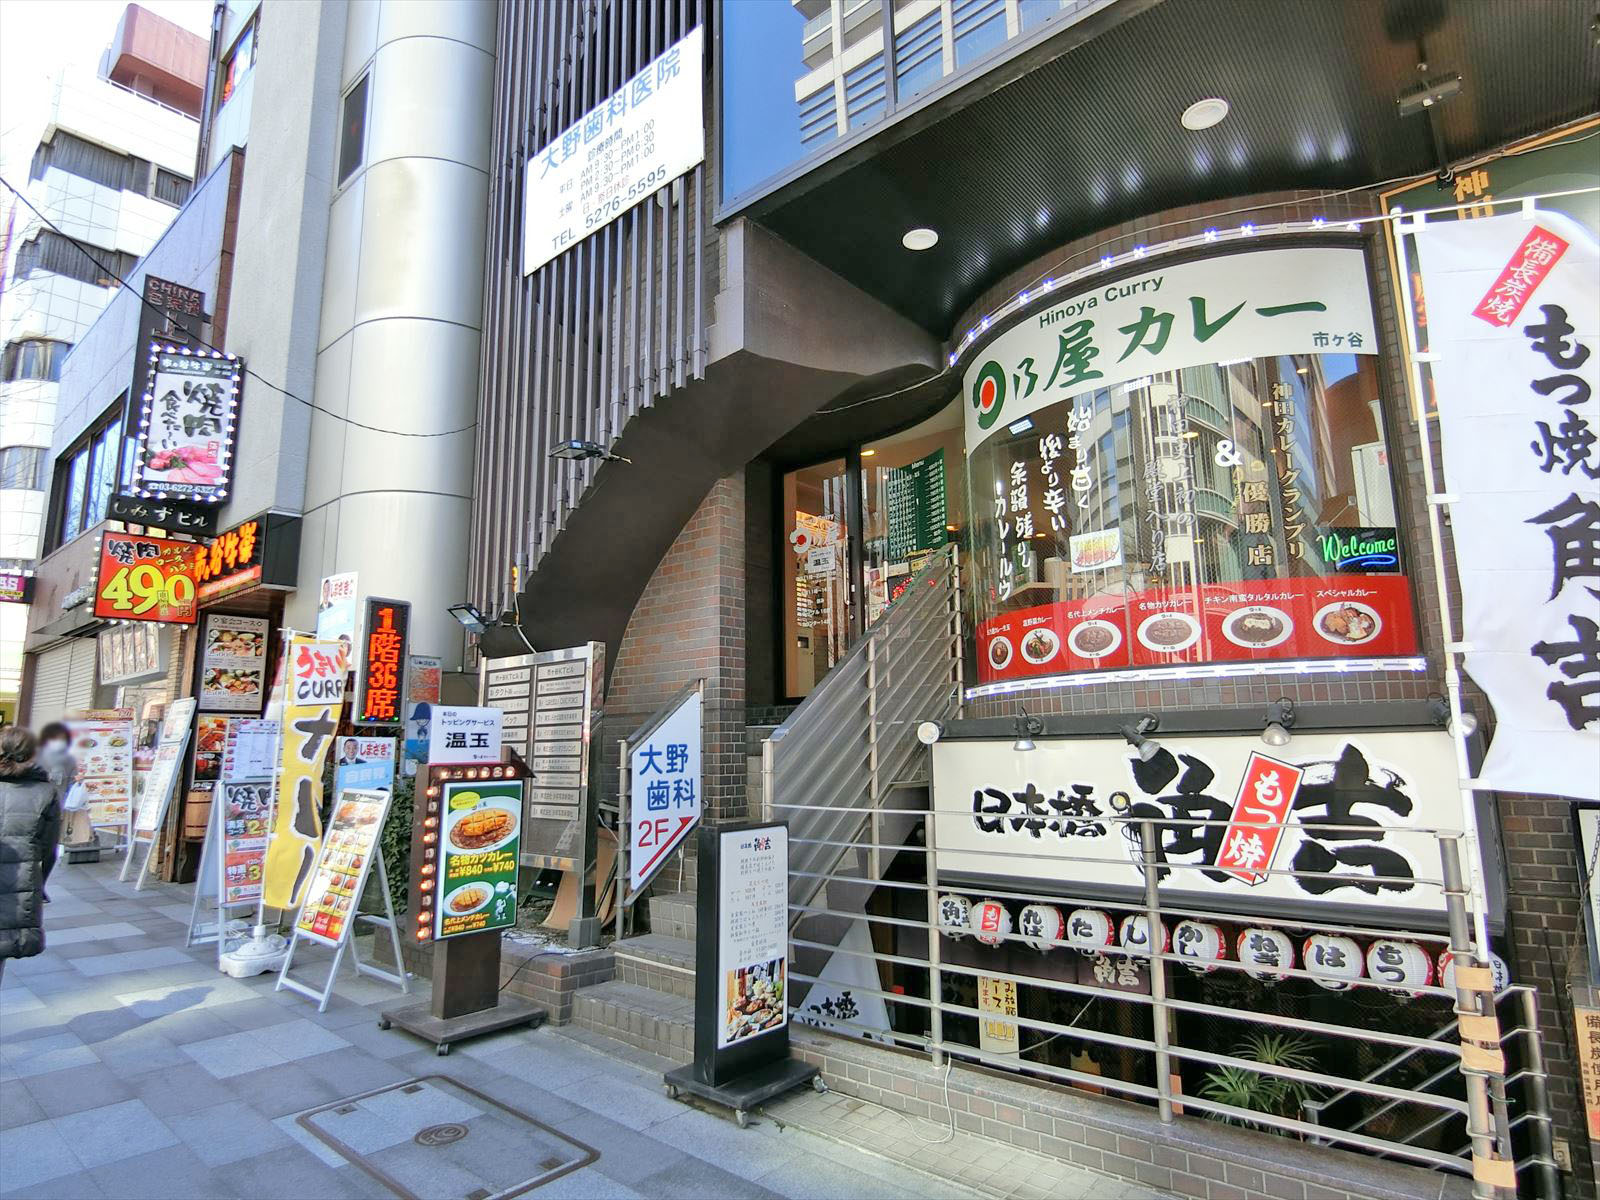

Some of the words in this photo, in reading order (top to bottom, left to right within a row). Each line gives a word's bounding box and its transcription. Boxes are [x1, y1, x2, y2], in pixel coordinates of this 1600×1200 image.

[540, 48, 680, 179] 大野歯科医院
[551, 227, 576, 250] TEL
[585, 164, 667, 229] 5276-5595
[1482, 235, 1558, 324] 備長炭焼
[1039, 296, 1099, 329] Hinoya
[1104, 276, 1164, 303] Curry
[1312, 331, 1364, 349] 市ヶ谷
[183, 381, 226, 438] 焼肉
[1067, 406, 1092, 508] 始まり甘く
[1215, 440, 1243, 467] &
[1039, 433, 1066, 531] 後より辛い
[1272, 383, 1306, 560] 神田カレーグランプリ
[113, 500, 209, 527] しみずビル
[1243, 481, 1274, 566] 優勝店
[109, 540, 161, 565] 焼肉
[1316, 533, 1396, 562] Welcome
[101, 564, 195, 615] 490
[1316, 589, 1378, 598] スペシャルカレー
[364, 608, 401, 718] 1階36席
[441, 719, 495, 727] トッピングサービス
[445, 732, 490, 749] 温玉
[639, 743, 689, 776] 大野
[646, 778, 696, 811] 歯科
[974, 783, 1106, 838] 日本橋
[638, 818, 670, 848] 2F
[1223, 769, 1284, 872] もつ焼
[449, 851, 513, 867] 名物カツカレー
[460, 864, 483, 876] ¥840
[493, 860, 515, 872] ¥740
